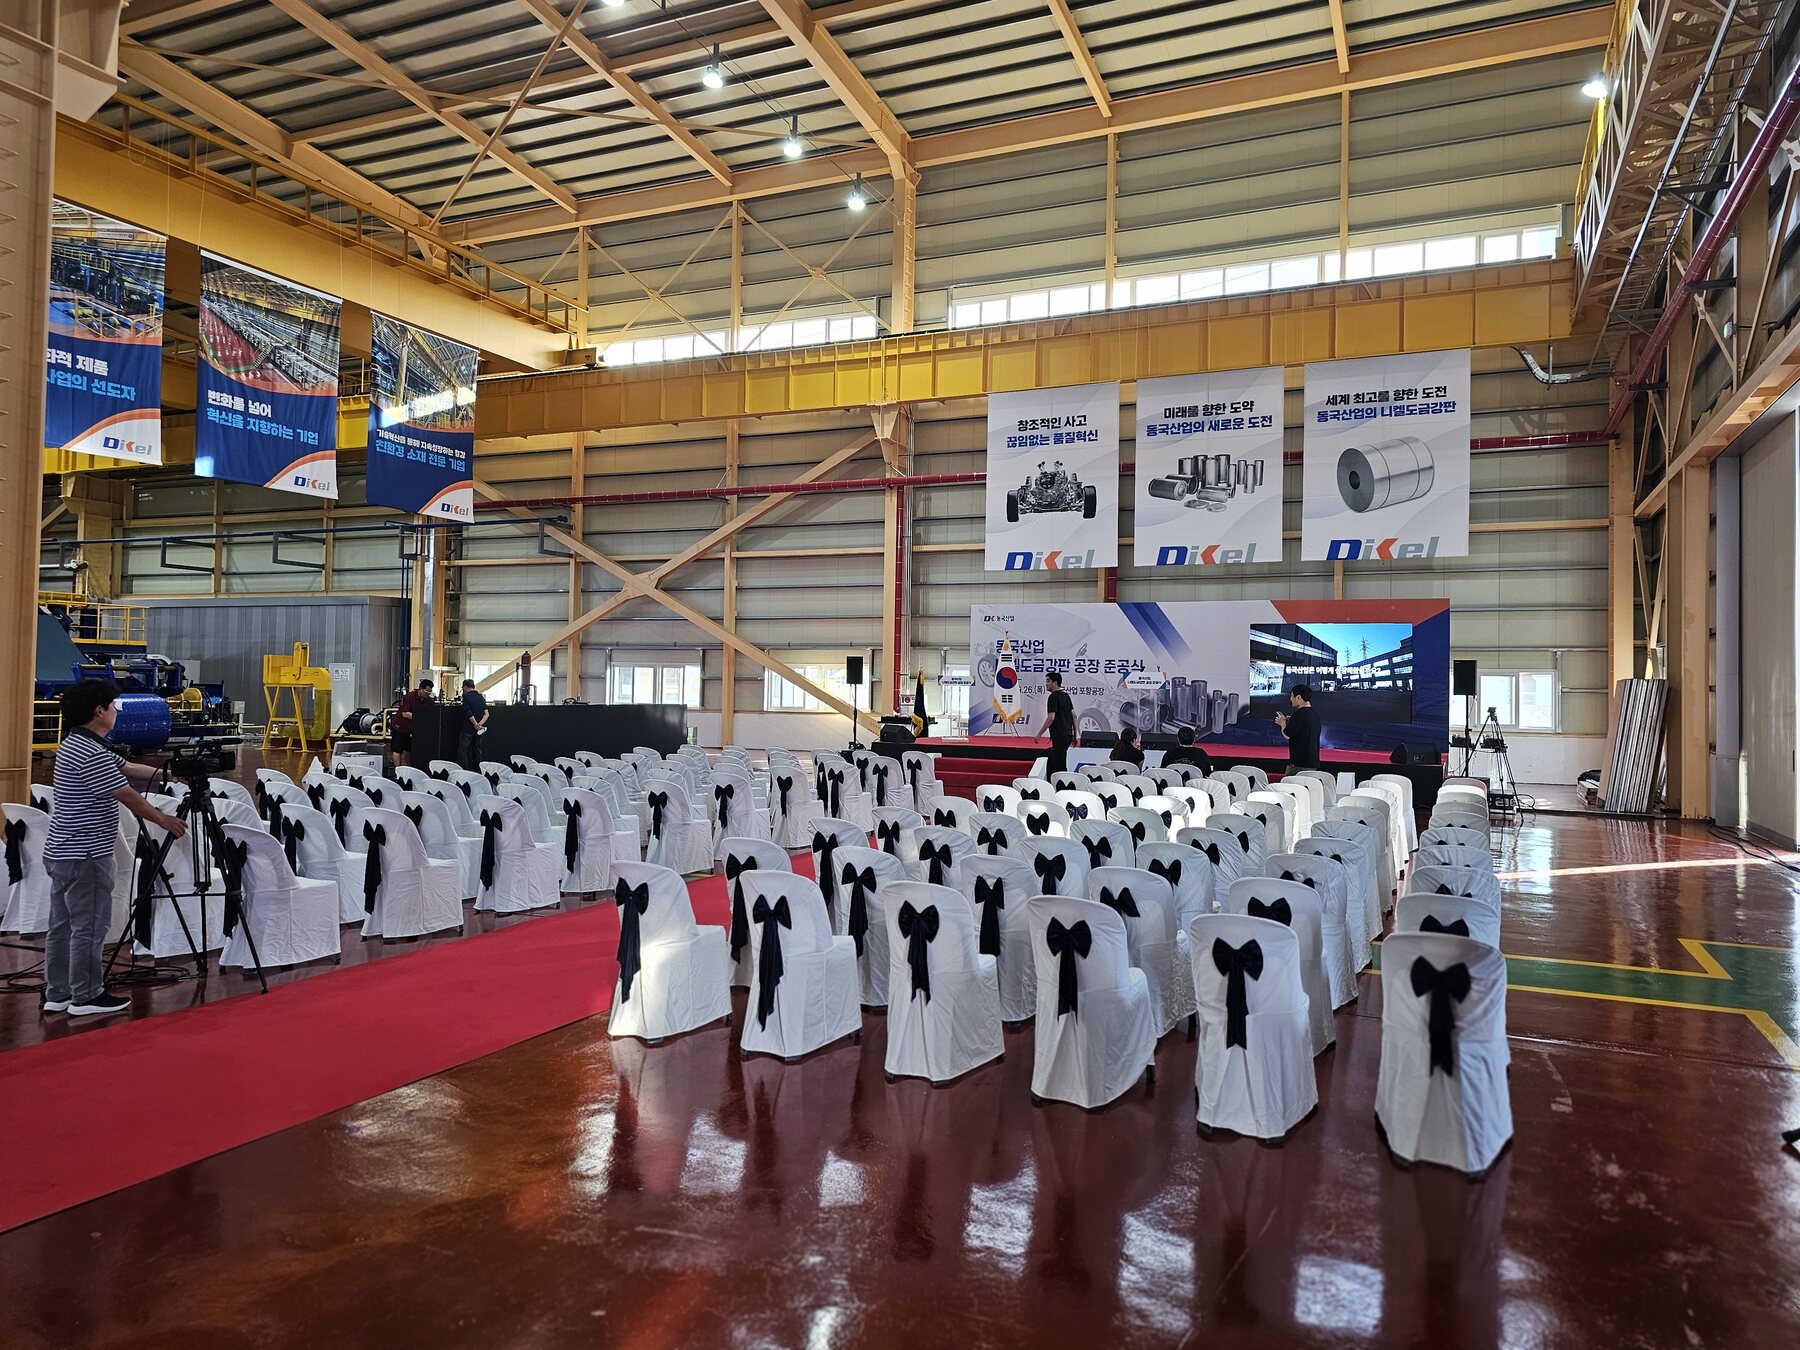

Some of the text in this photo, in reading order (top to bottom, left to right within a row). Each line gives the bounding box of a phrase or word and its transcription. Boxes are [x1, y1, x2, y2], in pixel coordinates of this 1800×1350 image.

[76, 355, 108, 376] 제품
[91, 378, 136, 401] 선도자
[1326, 386, 1447, 406] 세계 최고를 향한 도전
[207, 390, 272, 418] 변화를 넘어
[1164, 400, 1254, 419] 미래를 향한 도약
[1317, 401, 1456, 423] 동국산업의 니켈도금강판
[207, 407, 319, 446] 혁신을 지향하는 기업
[1017, 415, 1087, 431] 창조적인 사고
[1146, 415, 1273, 436] 동국산업의 새로운 도전
[1007, 430, 1098, 448] 끊임없는 품질혁신
[376, 439, 466, 472] 친환경 소재 전문 기업
[1075, 660, 1100, 674] 공장
[1104, 659, 1145, 674] 준공식
[1079, 686, 1104, 695] 포항공장
